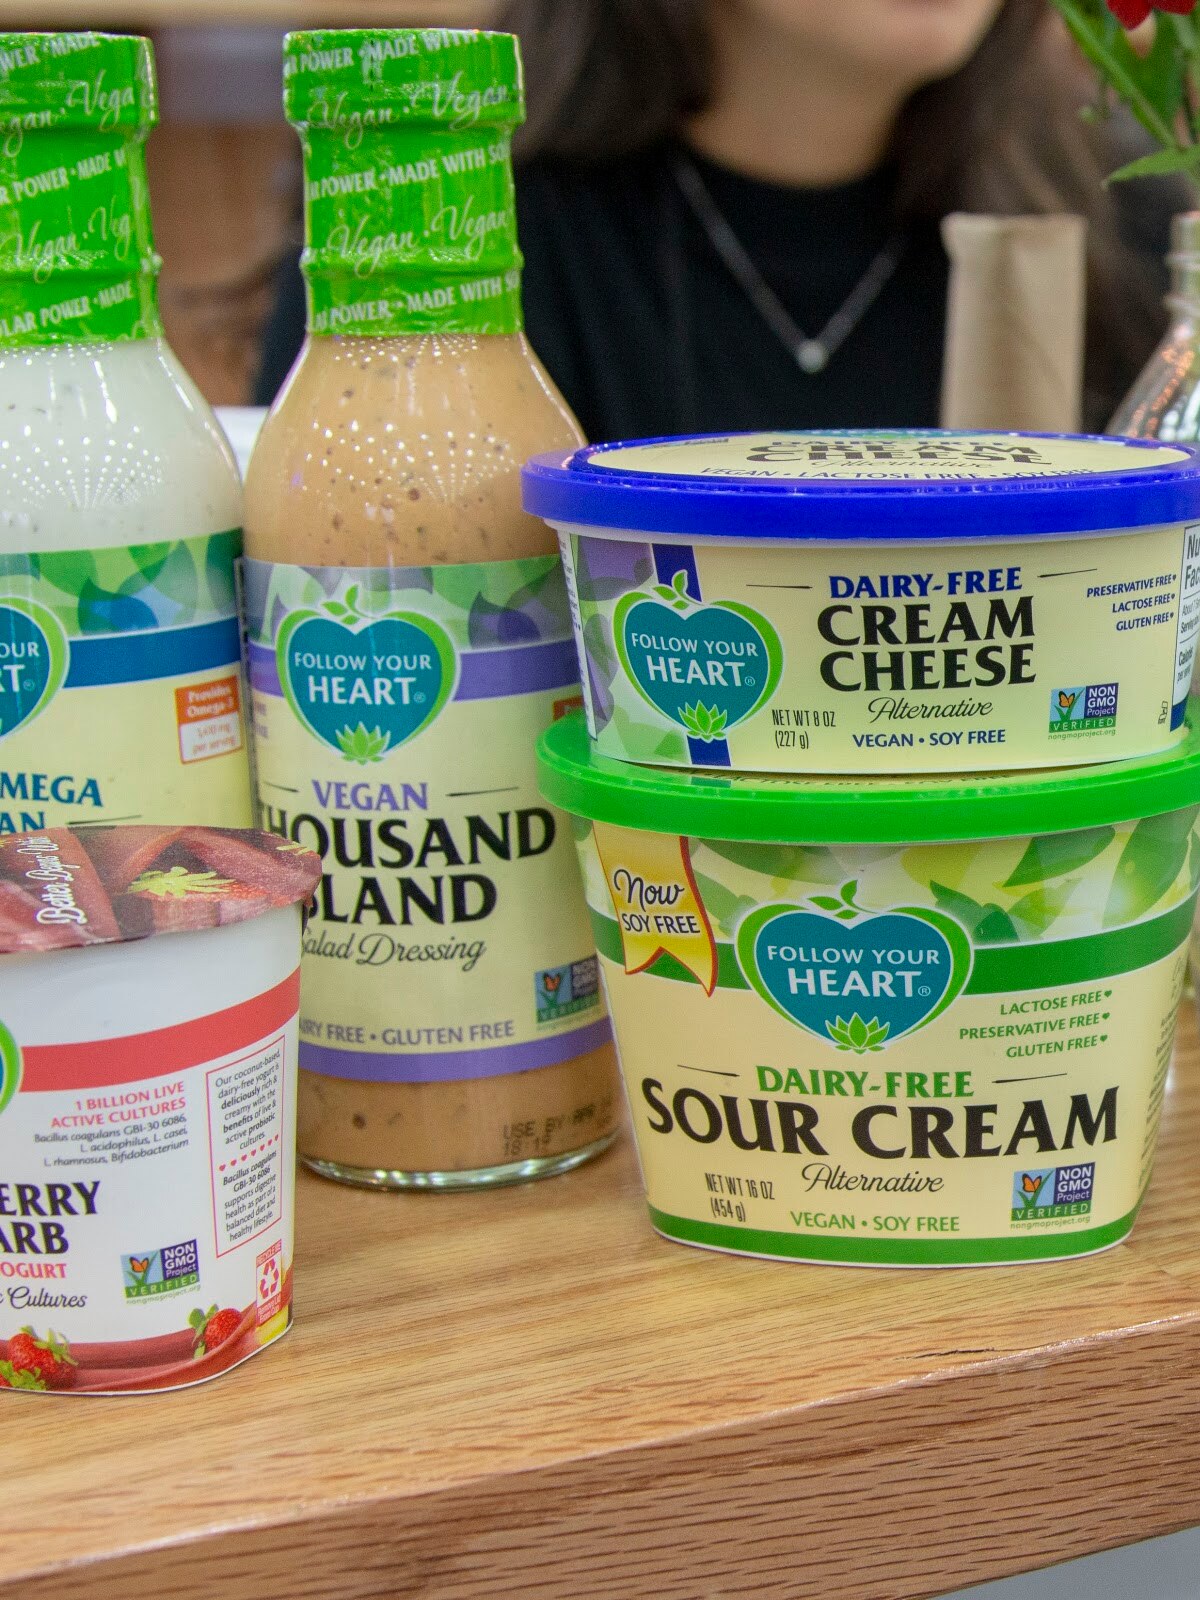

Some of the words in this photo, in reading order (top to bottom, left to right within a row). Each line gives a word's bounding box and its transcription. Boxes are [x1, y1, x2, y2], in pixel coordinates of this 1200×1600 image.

[301, 47, 354, 73] POWER
[367, 37, 419, 61] MADE
[306, 91, 394, 149] Vegan
[411, 70, 510, 131] Vegan
[12, 166, 70, 201] POWER
[76, 152, 112, 180] MADE
[322, 168, 377, 197] POWER
[388, 159, 439, 186] MADE
[442, 147, 485, 175] WITH
[326, 215, 418, 279] Vegan
[431, 194, 511, 262] Vegan
[0, 219, 80, 284] Vegan
[40, 295, 92, 327] POWER
[98, 280, 134, 309] MADE
[330, 300, 394, 328] POWER
[406, 286, 457, 313] MADE
[460, 275, 503, 302] WITH
[746, 451, 1052, 465] CHEESE
[700, 467, 778, 477] VEGAN
[829, 567, 1022, 598] DAIRY-FREE
[1087, 576, 1154, 598] PRESERVATIVE
[1155, 573, 1172, 587] FREE
[1112, 597, 1153, 613] LACTOSE
[1154, 593, 1171, 606] FREE
[817, 596, 1035, 646] CREAM
[1116, 615, 1152, 632] GLUTEN
[1153, 612, 1170, 625] FREE
[0, 641, 40, 658] OUR
[631, 632, 698, 653] FOLLOW
[703, 639, 758, 657] YOUR
[295, 652, 368, 671] FOLLOW
[373, 655, 432, 670] YOUR
[646, 655, 745, 687] HEART
[820, 643, 1036, 692] CHEESE
[308, 675, 417, 705] HEART
[1088, 686, 1116, 697] NON
[1088, 696, 1116, 708] GMO
[772, 709, 790, 726] NET
[793, 709, 810, 727] WT
[813, 710, 820, 727] 8
[823, 711, 836, 727] OZ
[868, 697, 993, 724] Alternative
[1087, 706, 1115, 717] Project
[1048, 728, 1116, 741] nongmoproject.org
[1053, 718, 1114, 731] VERIFIED
[775, 731, 795, 749] (227
[799, 731, 810, 750] g)
[852, 733, 913, 748] VEGAN
[929, 732, 963, 746] SOY
[968, 729, 1006, 744] FREE
[0, 772, 103, 807] MEGA
[311, 780, 428, 811] VEGAN
[265, 805, 556, 868] HOUSAND
[614, 869, 684, 912] Now
[36, 882, 88, 925] Better
[622, 913, 650, 933] SOY
[654, 915, 700, 934] FREE
[304, 928, 356, 960] alad
[356, 932, 488, 972] Dressing
[767, 945, 863, 964] FOLLOW
[872, 949, 940, 965] YOUR
[787, 968, 921, 998] HEART
[1000, 996, 1068, 1016] LACTOSE
[1071, 990, 1102, 1006] FREE
[327, 1024, 365, 1043] FREE
[381, 1027, 464, 1046] GLUTEN
[471, 1020, 515, 1039] FREE
[959, 1019, 1067, 1040] PRESERVATIVE
[1069, 1012, 1100, 1028] FREE
[1006, 1040, 1064, 1058] GLUTEN
[1067, 1034, 1098, 1050] FREE
[215, 1075, 232, 1087] Our
[234, 1049, 280, 1081] coconut-based
[218, 1078, 254, 1099] dairy-free
[755, 1065, 975, 1098] DAIRY-FREE
[75, 1101, 82, 1111] 1
[87, 1090, 150, 1111] BILLION
[154, 1080, 185, 1099] LIVE
[221, 1086, 260, 1110] deliciously
[51, 1113, 104, 1129] ACTIVE
[109, 1097, 186, 1124] CULTURES
[223, 1114, 253, 1133] benefits
[224, 1103, 251, 1120] creamy
[641, 1077, 829, 1156] SOUR
[851, 1085, 1120, 1159] CREAM
[34, 1133, 68, 1143] Bacillus
[71, 1130, 121, 1144] coagulans
[124, 1121, 160, 1136] GBI-30
[225, 1129, 247, 1144] active
[248, 1111, 275, 1136] probiotic
[111, 1138, 189, 1163] Bifidobacterium
[223, 1168, 250, 1186] Bacillus
[250, 1150, 277, 1172] coagulans
[801, 1162, 944, 1193] Alternative
[1059, 1166, 1091, 1181] NON
[224, 1189, 253, 1209] supports
[255, 1174, 276, 1193] digestive
[705, 1172, 725, 1194] NET
[727, 1175, 743, 1195] WT
[746, 1179, 758, 1198] 16
[760, 1181, 775, 1200] OZ
[1057, 1190, 1090, 1203] Project
[1058, 1178, 1091, 1192] GMO
[0, 1181, 100, 1216] ERRY
[710, 1198, 733, 1219] (454
[736, 1201, 746, 1223] g)
[225, 1204, 247, 1220] health
[226, 1209, 255, 1232] balanced
[790, 1211, 855, 1230] VEGAN
[873, 1216, 911, 1231] SOY
[917, 1216, 960, 1232] FREE
[1010, 1215, 1091, 1230] nongmoproject.org
[1016, 1203, 1089, 1220] VERIFIED
[229, 1224, 253, 1242] healthy
[164, 1242, 195, 1260] NON
[165, 1253, 196, 1270] GMO
[0, 1261, 67, 1279] OGURT
[166, 1263, 197, 1280] Project
[8, 1286, 88, 1310] Cultures
[130, 1274, 198, 1297] VERIFIED
